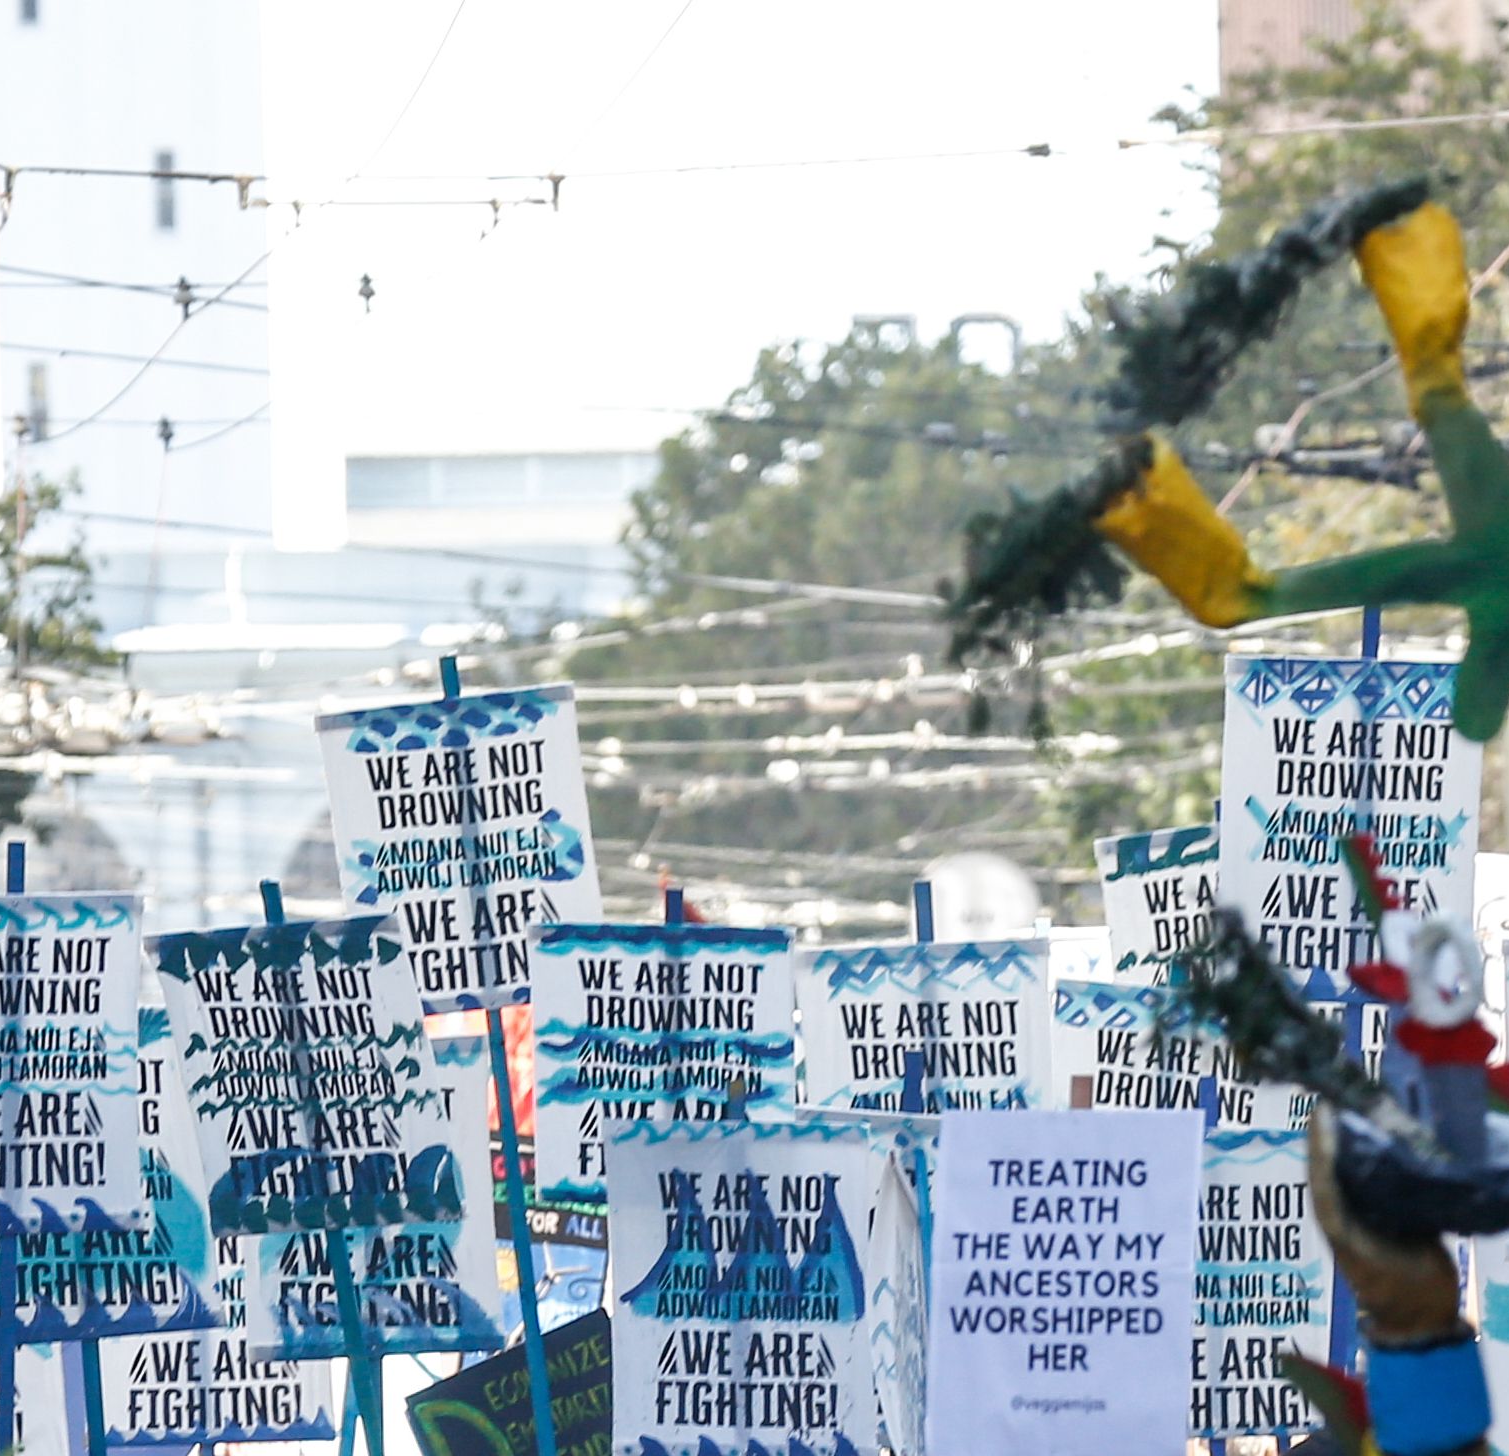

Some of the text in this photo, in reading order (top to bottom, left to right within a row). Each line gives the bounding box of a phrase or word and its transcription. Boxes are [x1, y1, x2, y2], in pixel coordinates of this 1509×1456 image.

[1274, 718, 1454, 760] WE ARE NOT
[366, 740, 545, 791] WE ARE NOT
[1277, 760, 1443, 801] DROWNING
[377, 780, 543, 829] DROWNING
[1281, 809, 1357, 836] MOANA
[1368, 814, 1401, 839] NUI
[390, 838, 467, 866] MOANA
[474, 830, 509, 858] NUI
[1262, 837, 1340, 865] ADWOJ
[378, 851, 557, 893] ADWOJ LAMORAN
[1144, 878, 1186, 914] WE
[1286, 874, 1339, 920] WE
[404, 890, 536, 944] WE ARE
[52, 937, 111, 974] NOT
[194, 967, 373, 1004] WE ARE NOT
[578, 959, 765, 996] WE ARE NOT
[209, 1004, 376, 1041] DROWNING
[587, 995, 754, 1033] DROWNING
[841, 1000, 1020, 1039] WE ARE NOT
[26, 1029, 61, 1053] NUI
[1097, 1029, 1203, 1075] WE ARE
[9, 1053, 108, 1081] LAMORAN
[577, 1067, 654, 1091] ADWOJ
[14, 1092, 82, 1138] ARE
[246, 1106, 384, 1152] WE ARE
[989, 1160, 1147, 1187] TREATING
[659, 1174, 841, 1214] WE ARE NOT
[1012, 1197, 1119, 1224] EARTH
[1252, 1183, 1308, 1221] NOT
[565, 1215, 602, 1239] ALL
[666, 1215, 833, 1255] DROWNING
[366, 1234, 438, 1278] ARE
[953, 1233, 1165, 1260] THE WAY MY
[964, 1270, 1159, 1297] ANCESTORS
[1230, 1274, 1264, 1299] NUI
[656, 1292, 839, 1321] ADWOJ LAMORAN
[950, 1306, 1163, 1335] WORSHIPPED
[1214, 1298, 1310, 1326] LAMORAN
[153, 1341, 202, 1383] WE
[681, 1330, 814, 1377] WE ARE
[1028, 1344, 1089, 1372] HER
[1220, 1337, 1286, 1381] ARE
[128, 1385, 302, 1430] FIGHTING!
[655, 1381, 838, 1429] FIGHTING!
